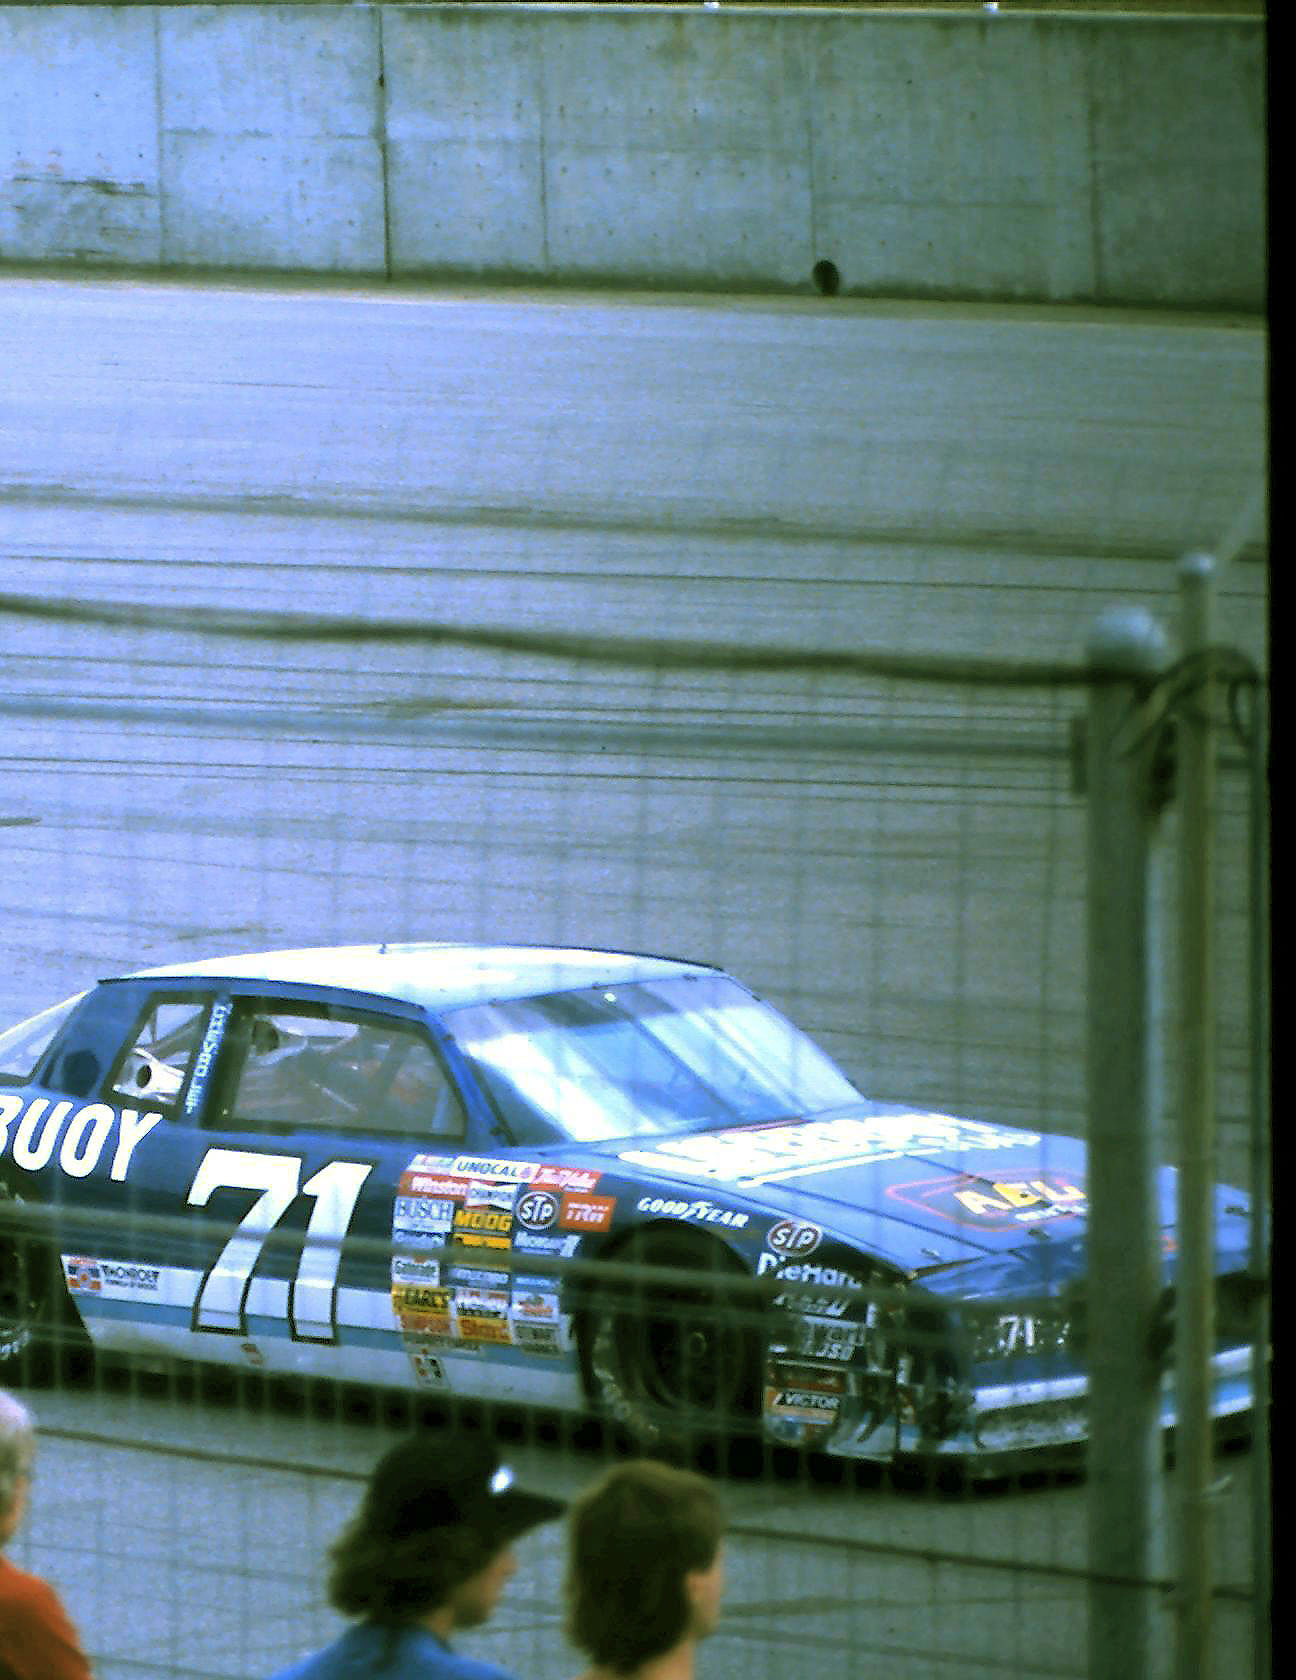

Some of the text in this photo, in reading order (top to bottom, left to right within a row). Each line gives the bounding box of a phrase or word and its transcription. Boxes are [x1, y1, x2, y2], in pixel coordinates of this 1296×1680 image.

[457, 1160, 518, 1177] UNOCAL
[455, 1210, 513, 1232] MOOG
[520, 1195, 553, 1223] STP
[637, 1197, 750, 1229] GOODYEAR
[187, 1146, 374, 1346] 71
[771, 1226, 818, 1251] STP
